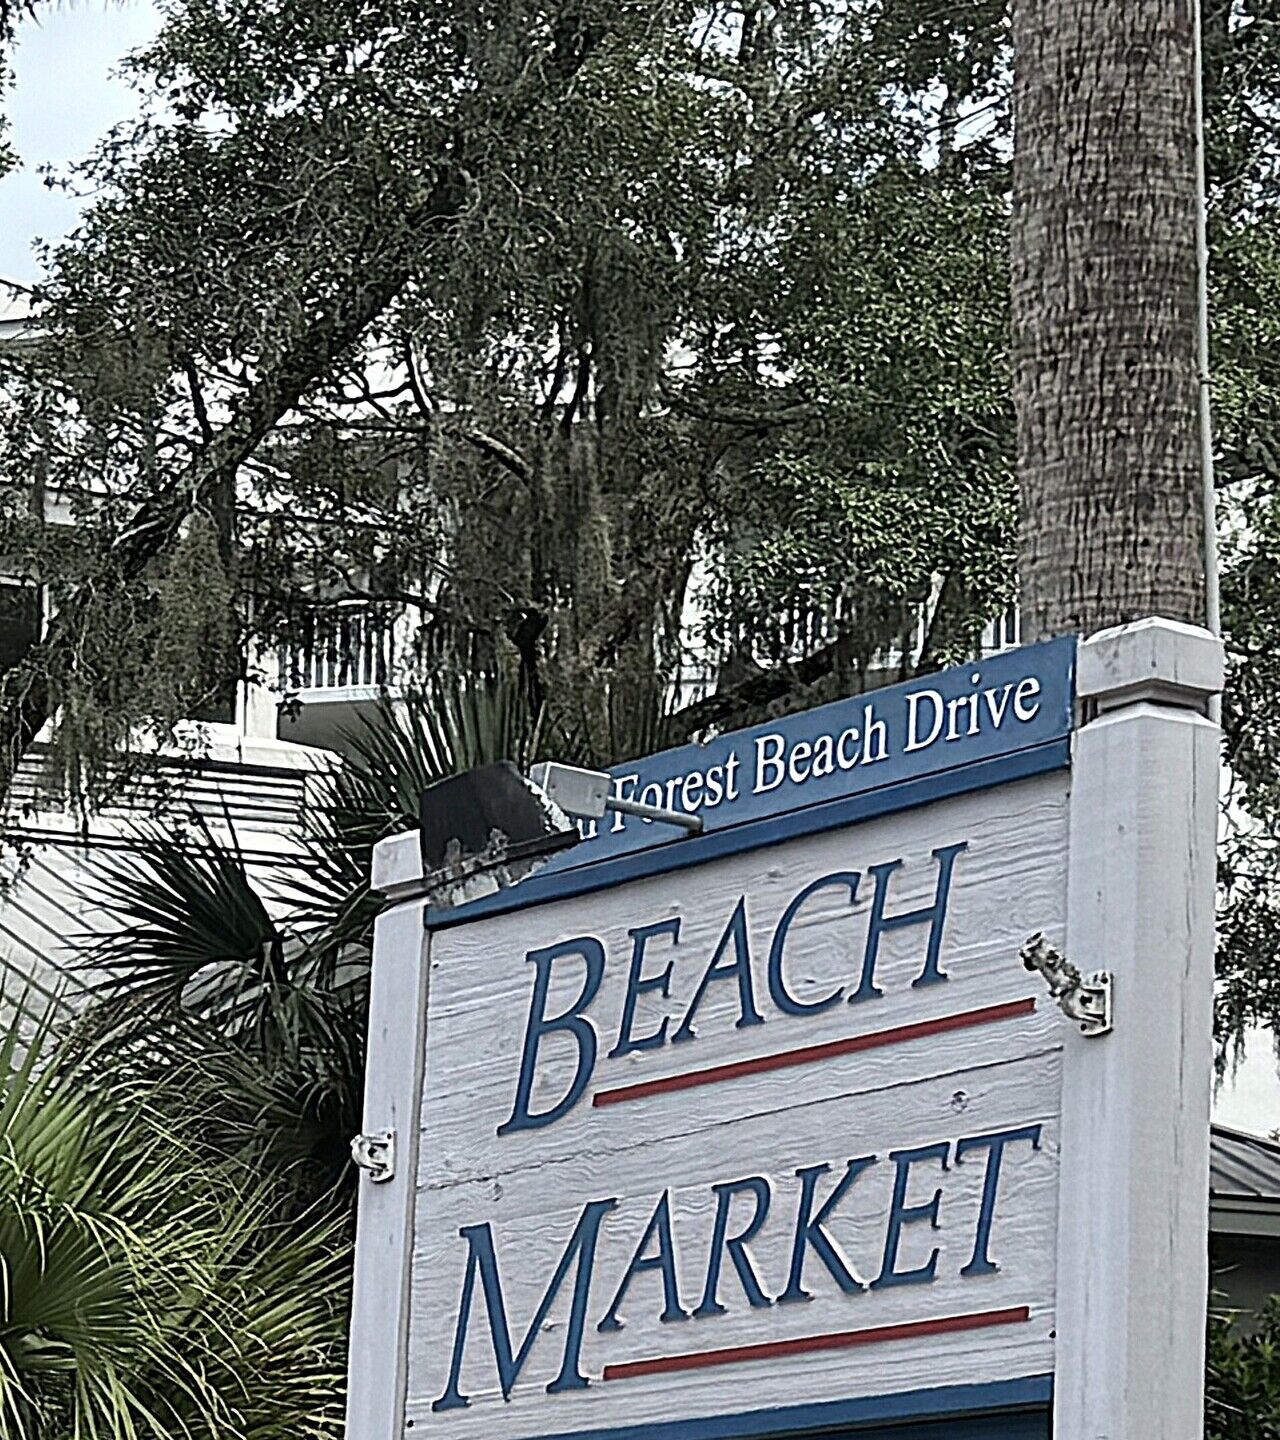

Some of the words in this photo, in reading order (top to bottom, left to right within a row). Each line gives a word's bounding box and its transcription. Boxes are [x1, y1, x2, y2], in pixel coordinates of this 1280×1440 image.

[610, 751, 740, 833] Forest
[753, 705, 888, 795] Beach
[904, 673, 1040, 754] Drive
[497, 841, 969, 1137] BEACH
[432, 1124, 1042, 1412] MARKET
